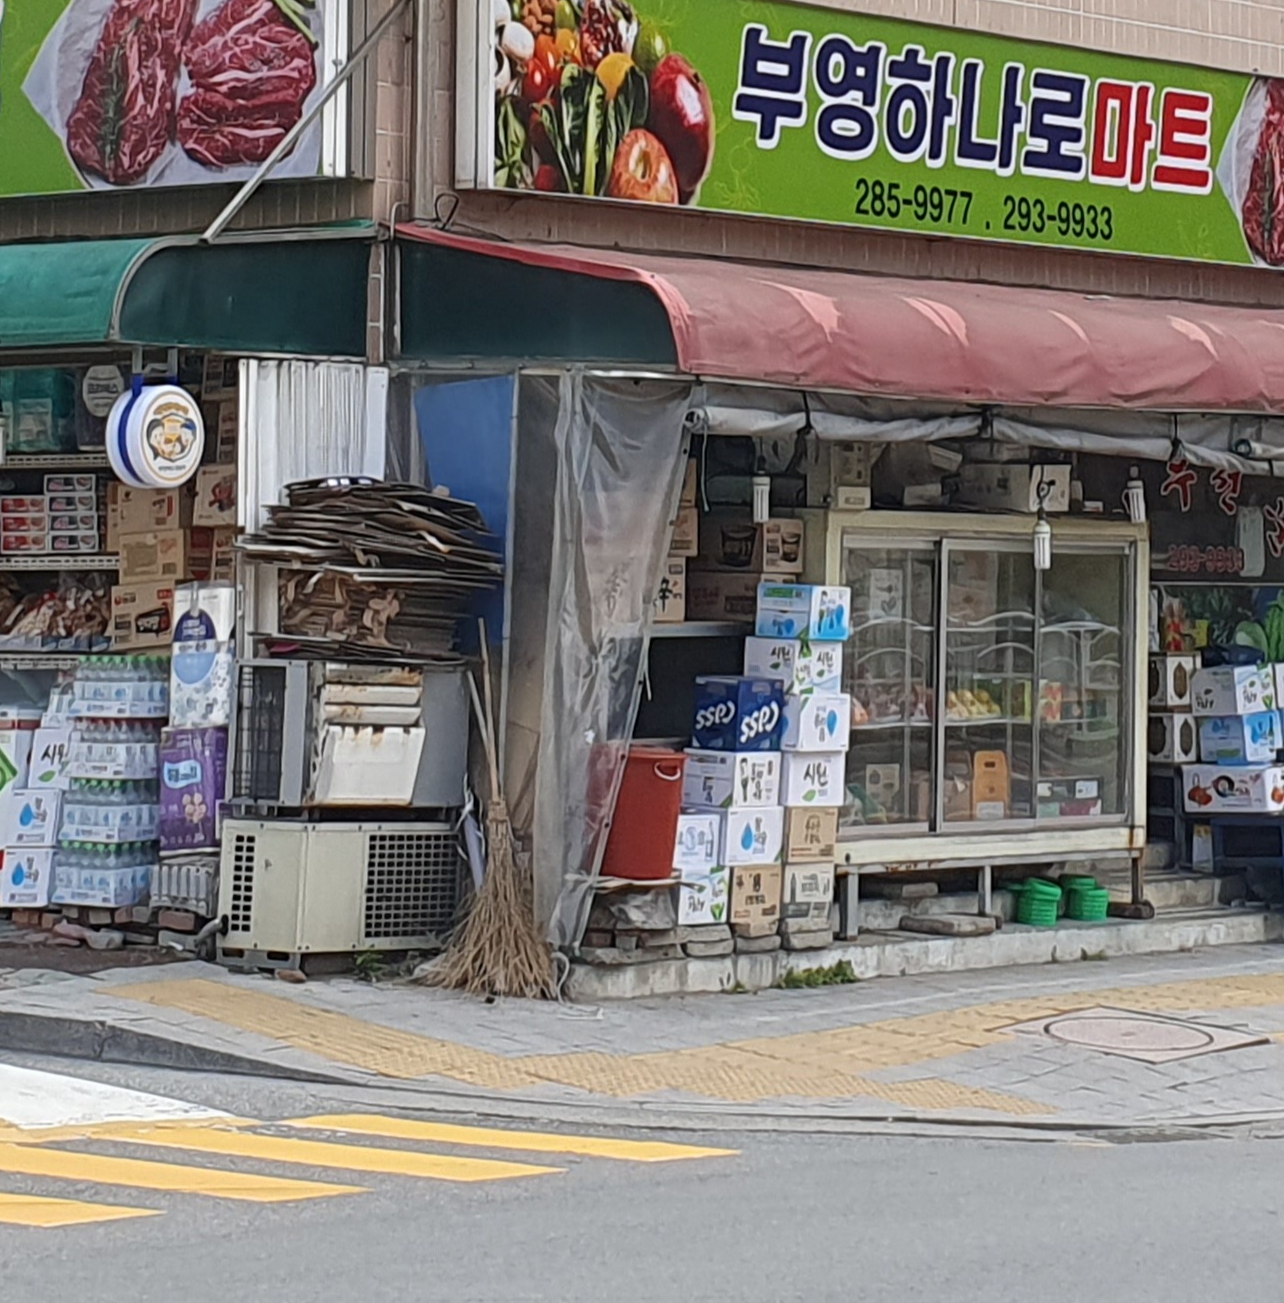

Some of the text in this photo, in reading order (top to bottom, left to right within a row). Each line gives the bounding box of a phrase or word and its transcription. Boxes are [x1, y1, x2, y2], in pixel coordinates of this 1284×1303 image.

[732, 22, 1215, 195] 부영하나로마트
[854, 177, 1115, 241] 285-9977 293-9933
